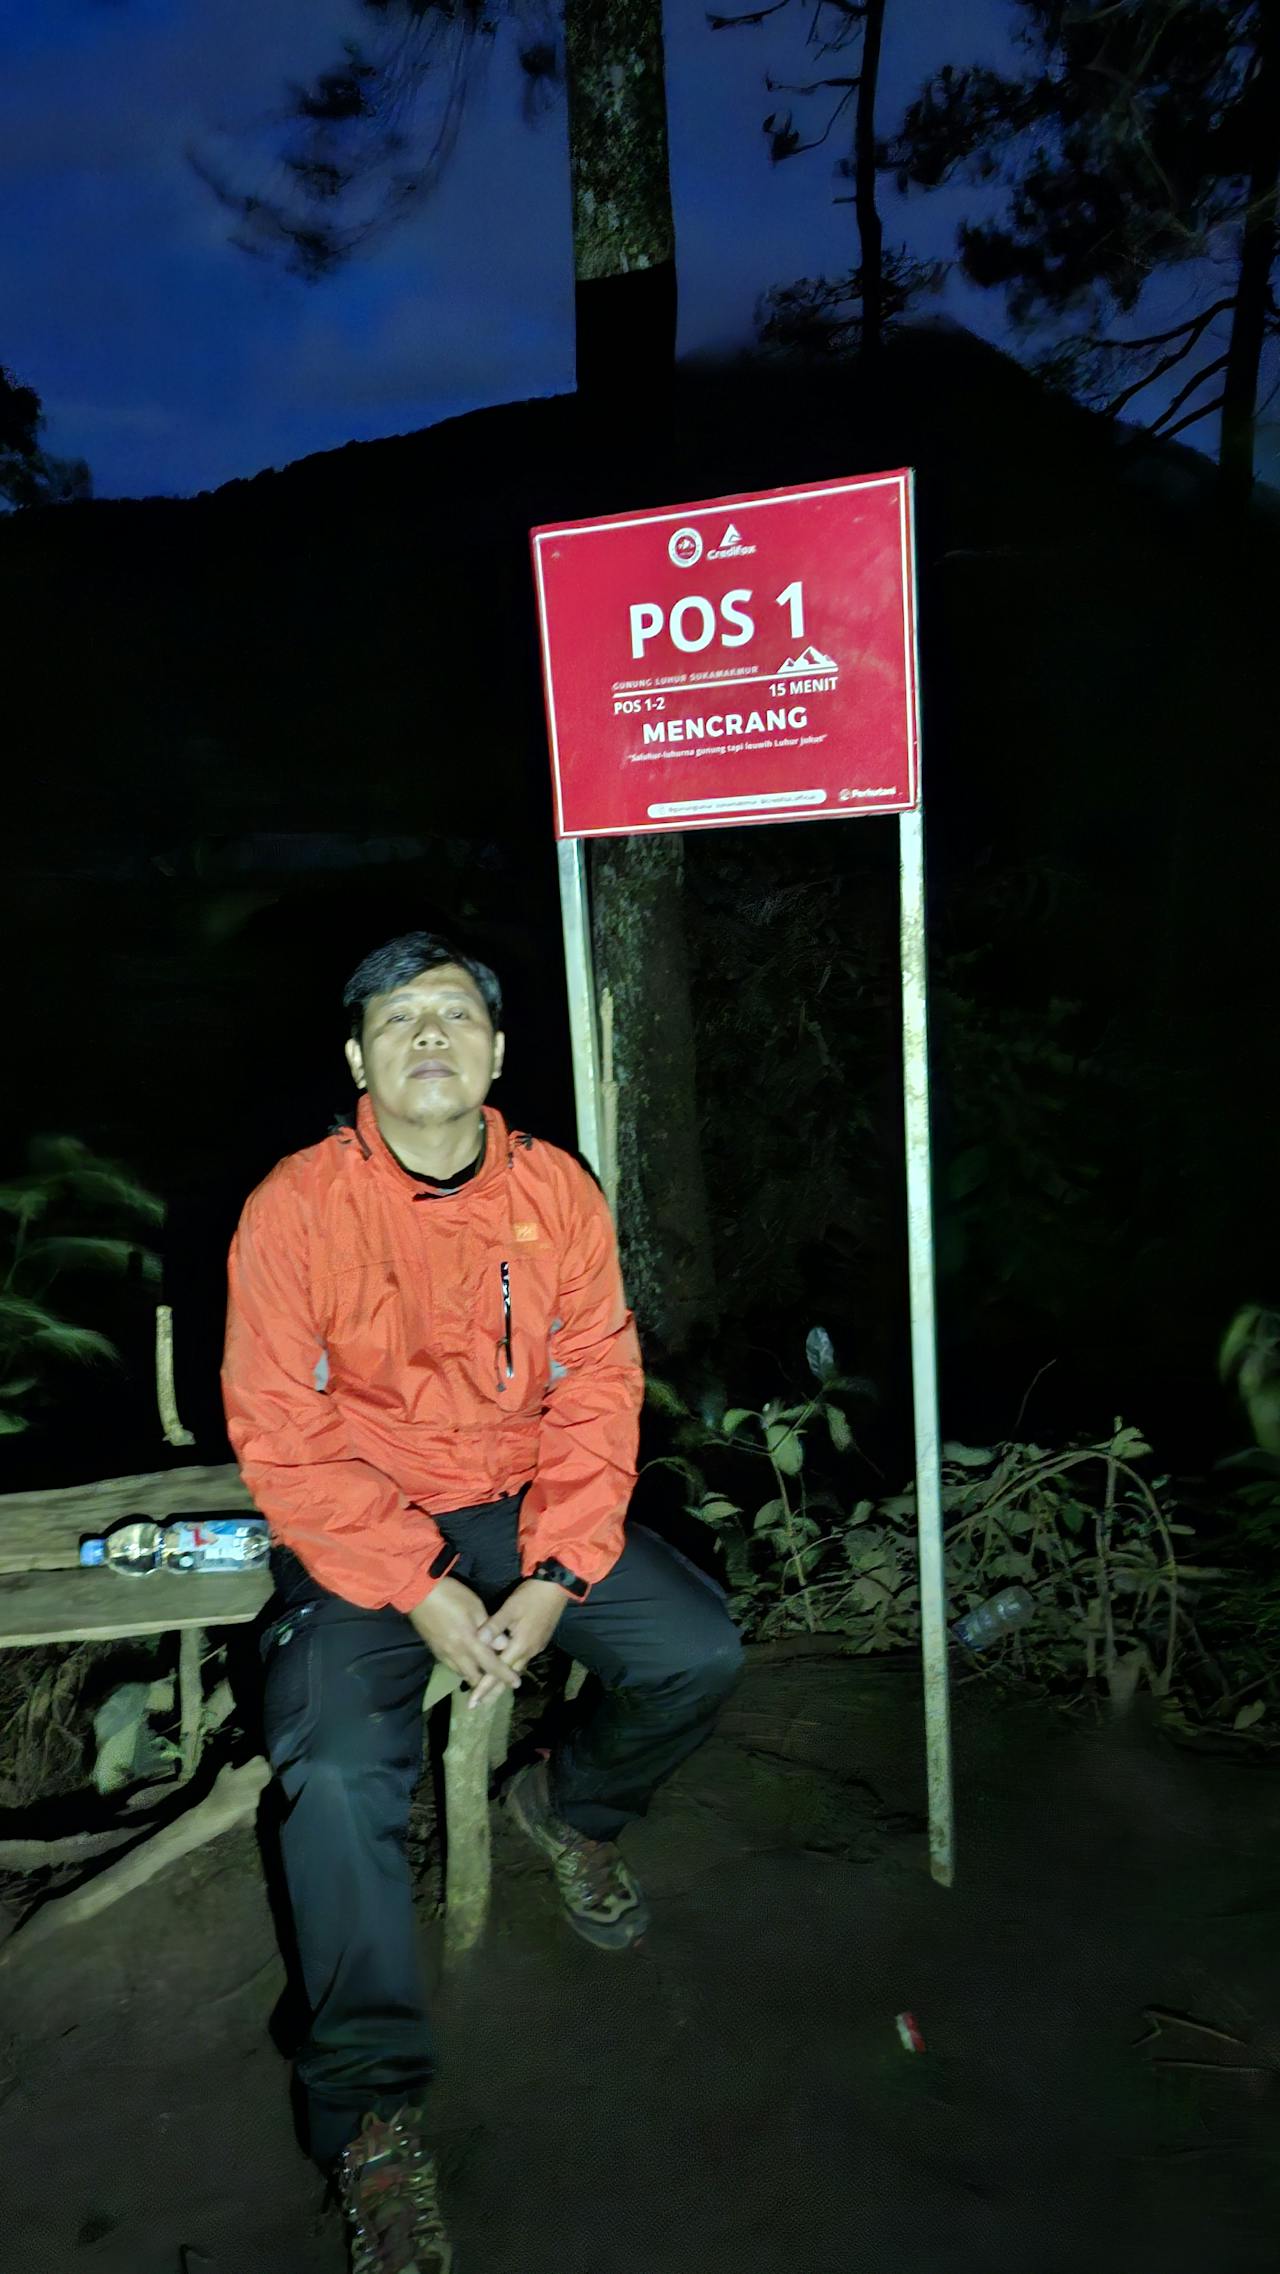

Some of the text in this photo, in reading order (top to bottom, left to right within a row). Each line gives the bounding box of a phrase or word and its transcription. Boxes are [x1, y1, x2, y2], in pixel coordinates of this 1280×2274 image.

[629, 581, 804, 659] POS 1
[611, 665, 759, 690] GUNUNG LUHUR SUKAMAKMUR
[768, 677, 839, 697] 15 MENIT
[614, 697, 666, 715] POS 1-2
[642, 706, 808, 744] MENCRANG
[695, 745, 726, 757] gunung
[727, 742, 744, 753] tapi
[774, 737, 799, 747] Luhur
